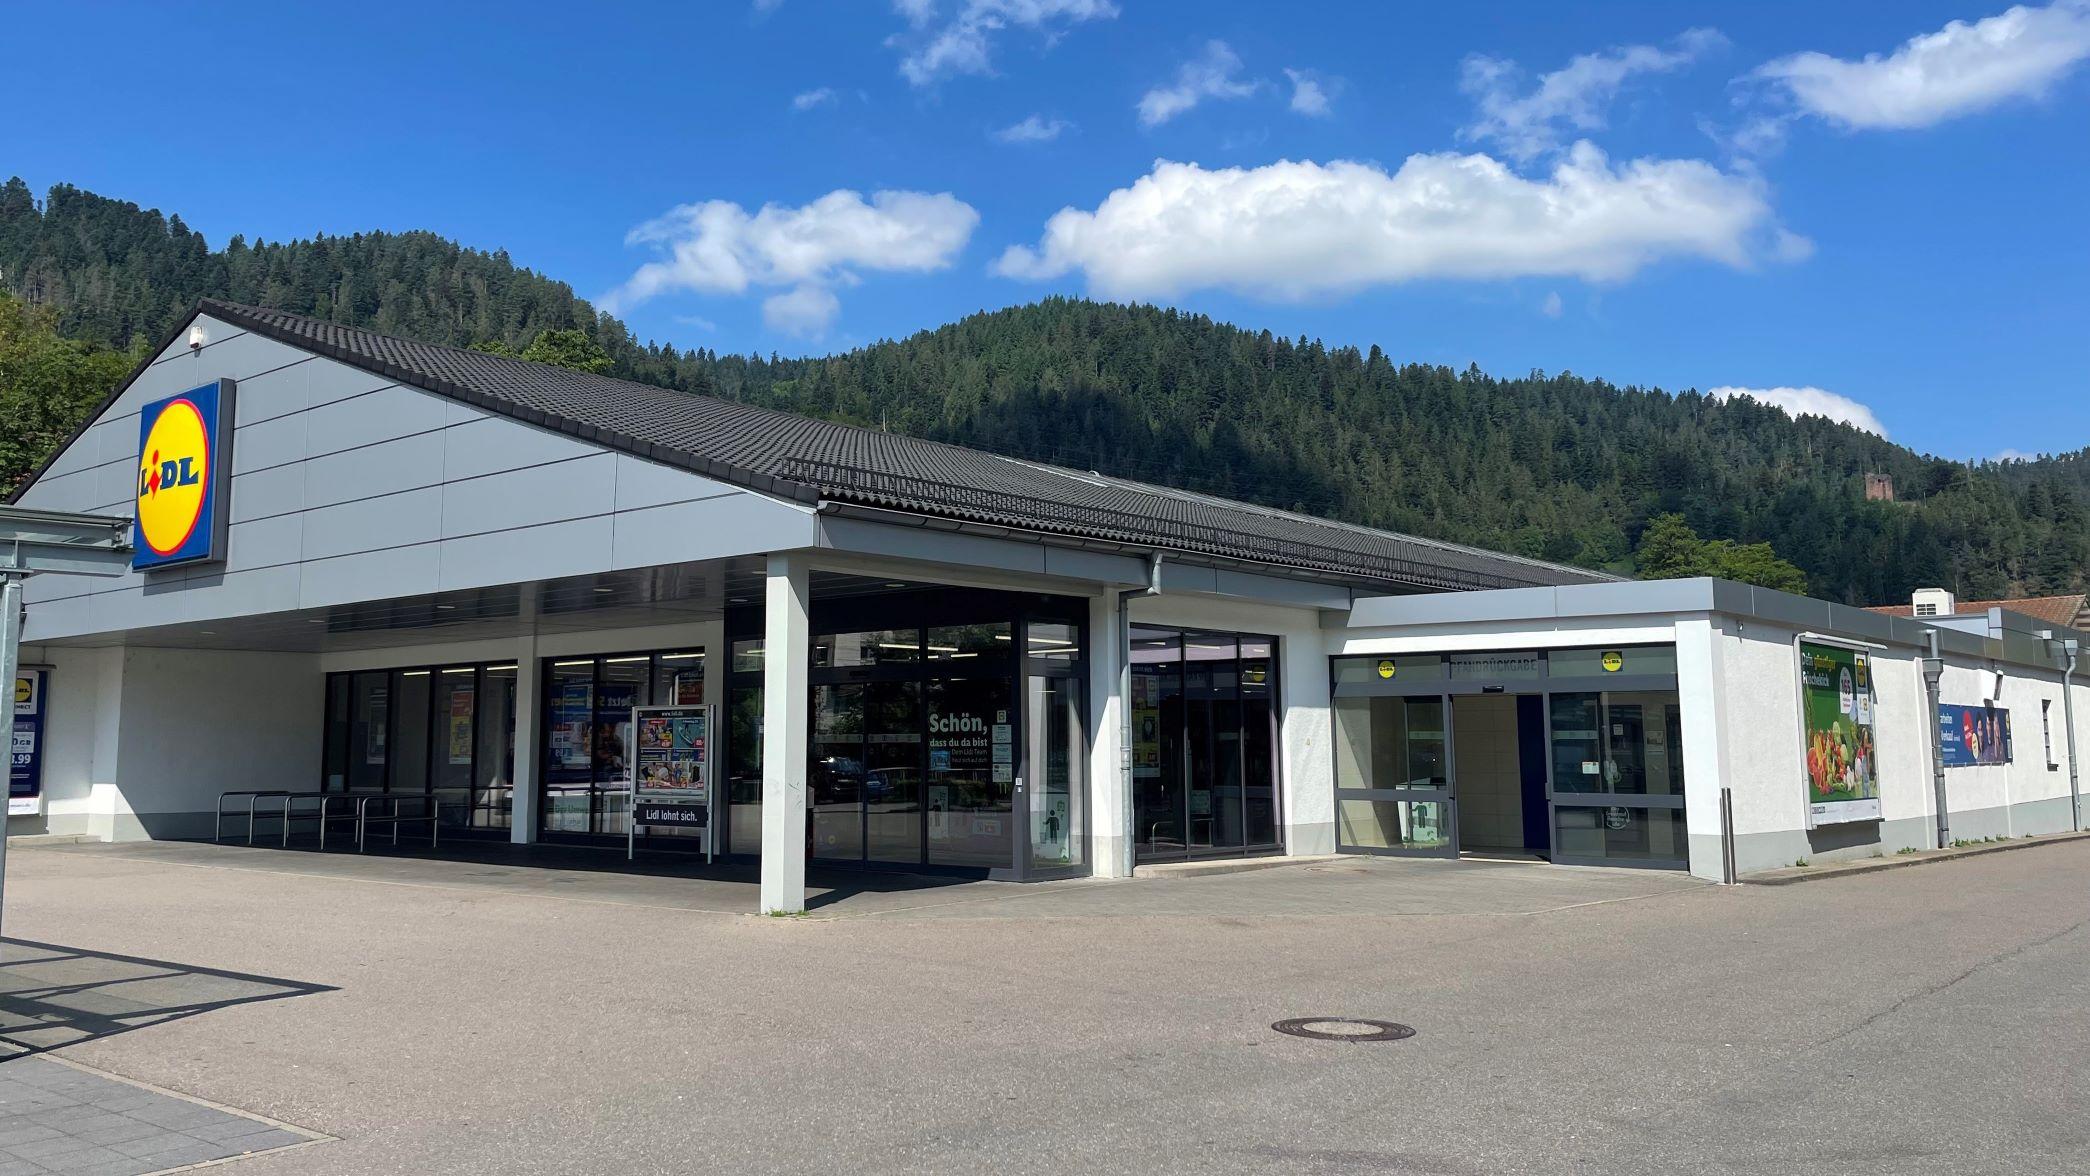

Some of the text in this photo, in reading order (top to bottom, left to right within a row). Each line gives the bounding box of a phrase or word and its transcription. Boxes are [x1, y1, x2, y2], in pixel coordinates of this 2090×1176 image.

[929, 712, 988, 735] Schön,
[930, 737, 988, 747] dass du da bist
[646, 809, 698, 822] Lidl lohnt sich.
